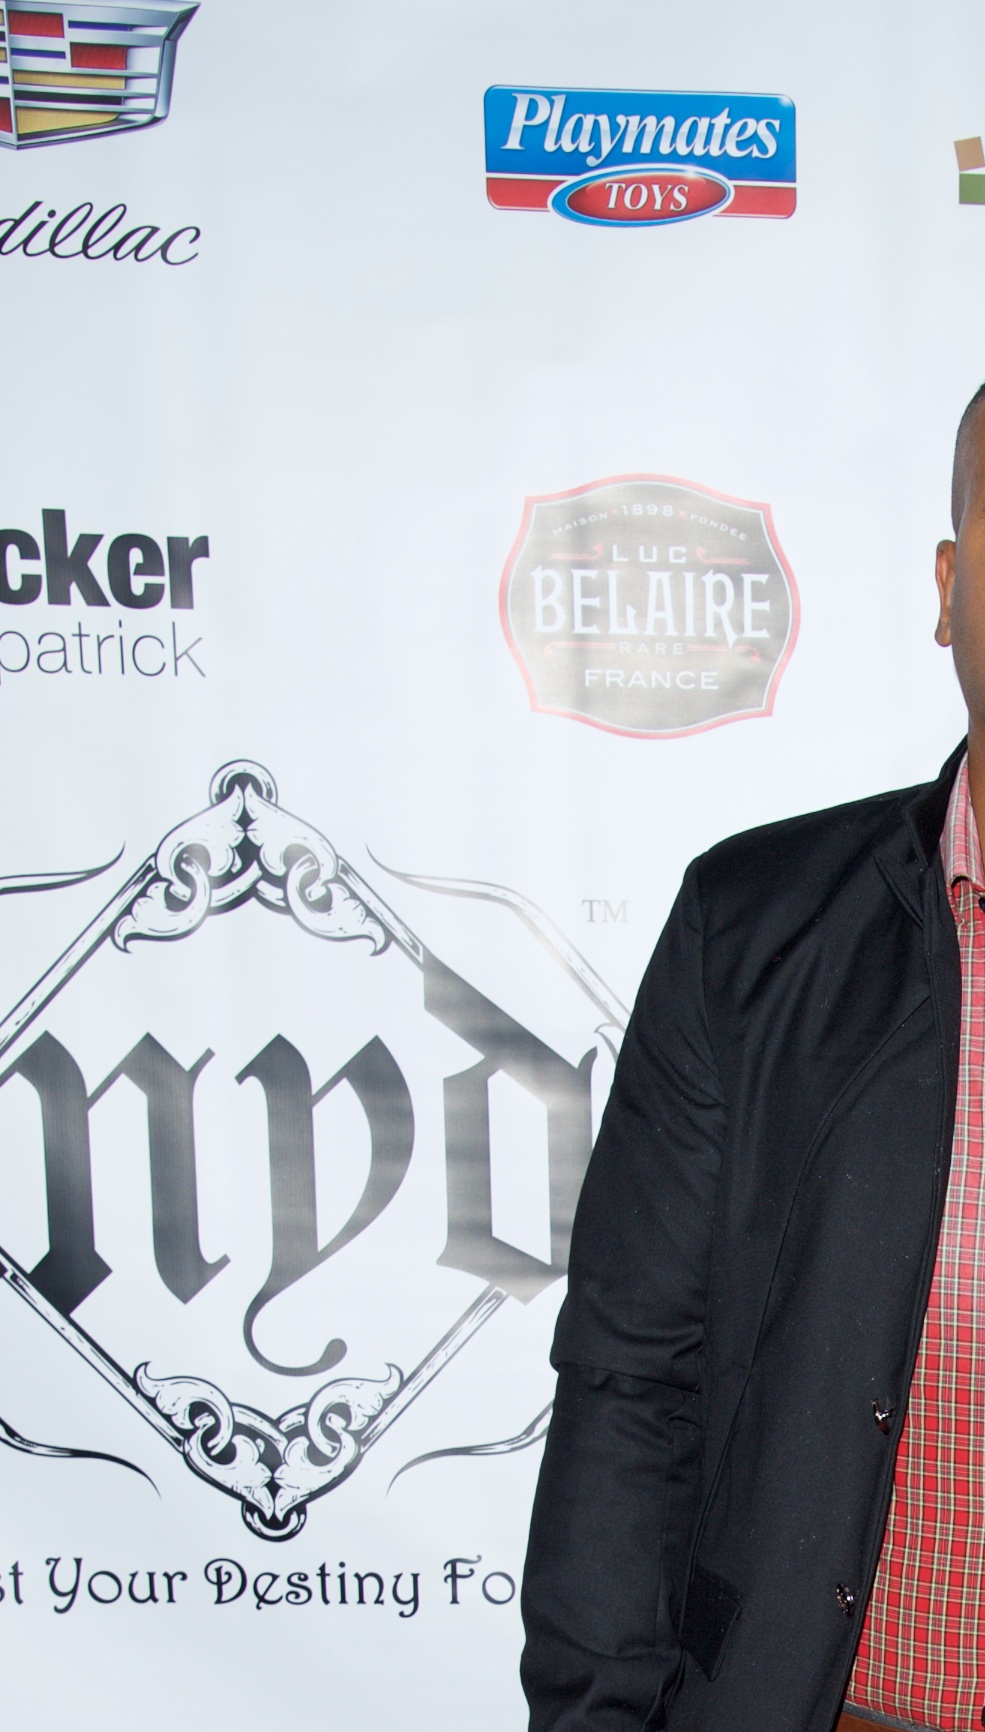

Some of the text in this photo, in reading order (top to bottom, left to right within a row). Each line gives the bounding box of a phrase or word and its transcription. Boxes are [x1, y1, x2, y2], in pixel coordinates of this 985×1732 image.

[501, 93, 782, 167] Playmates
[603, 181, 689, 212] TOYS
[552, 511, 608, 536] MAISON
[621, 504, 674, 517] 1898
[612, 544, 687, 563] LUC
[529, 565, 770, 649] BELAIRE
[619, 642, 684, 655] RARE
[585, 669, 719, 690] FRANCE
[582, 900, 629, 923] TM
[45, 1557, 187, 1614] Your
[204, 1558, 420, 1618] Destiny
